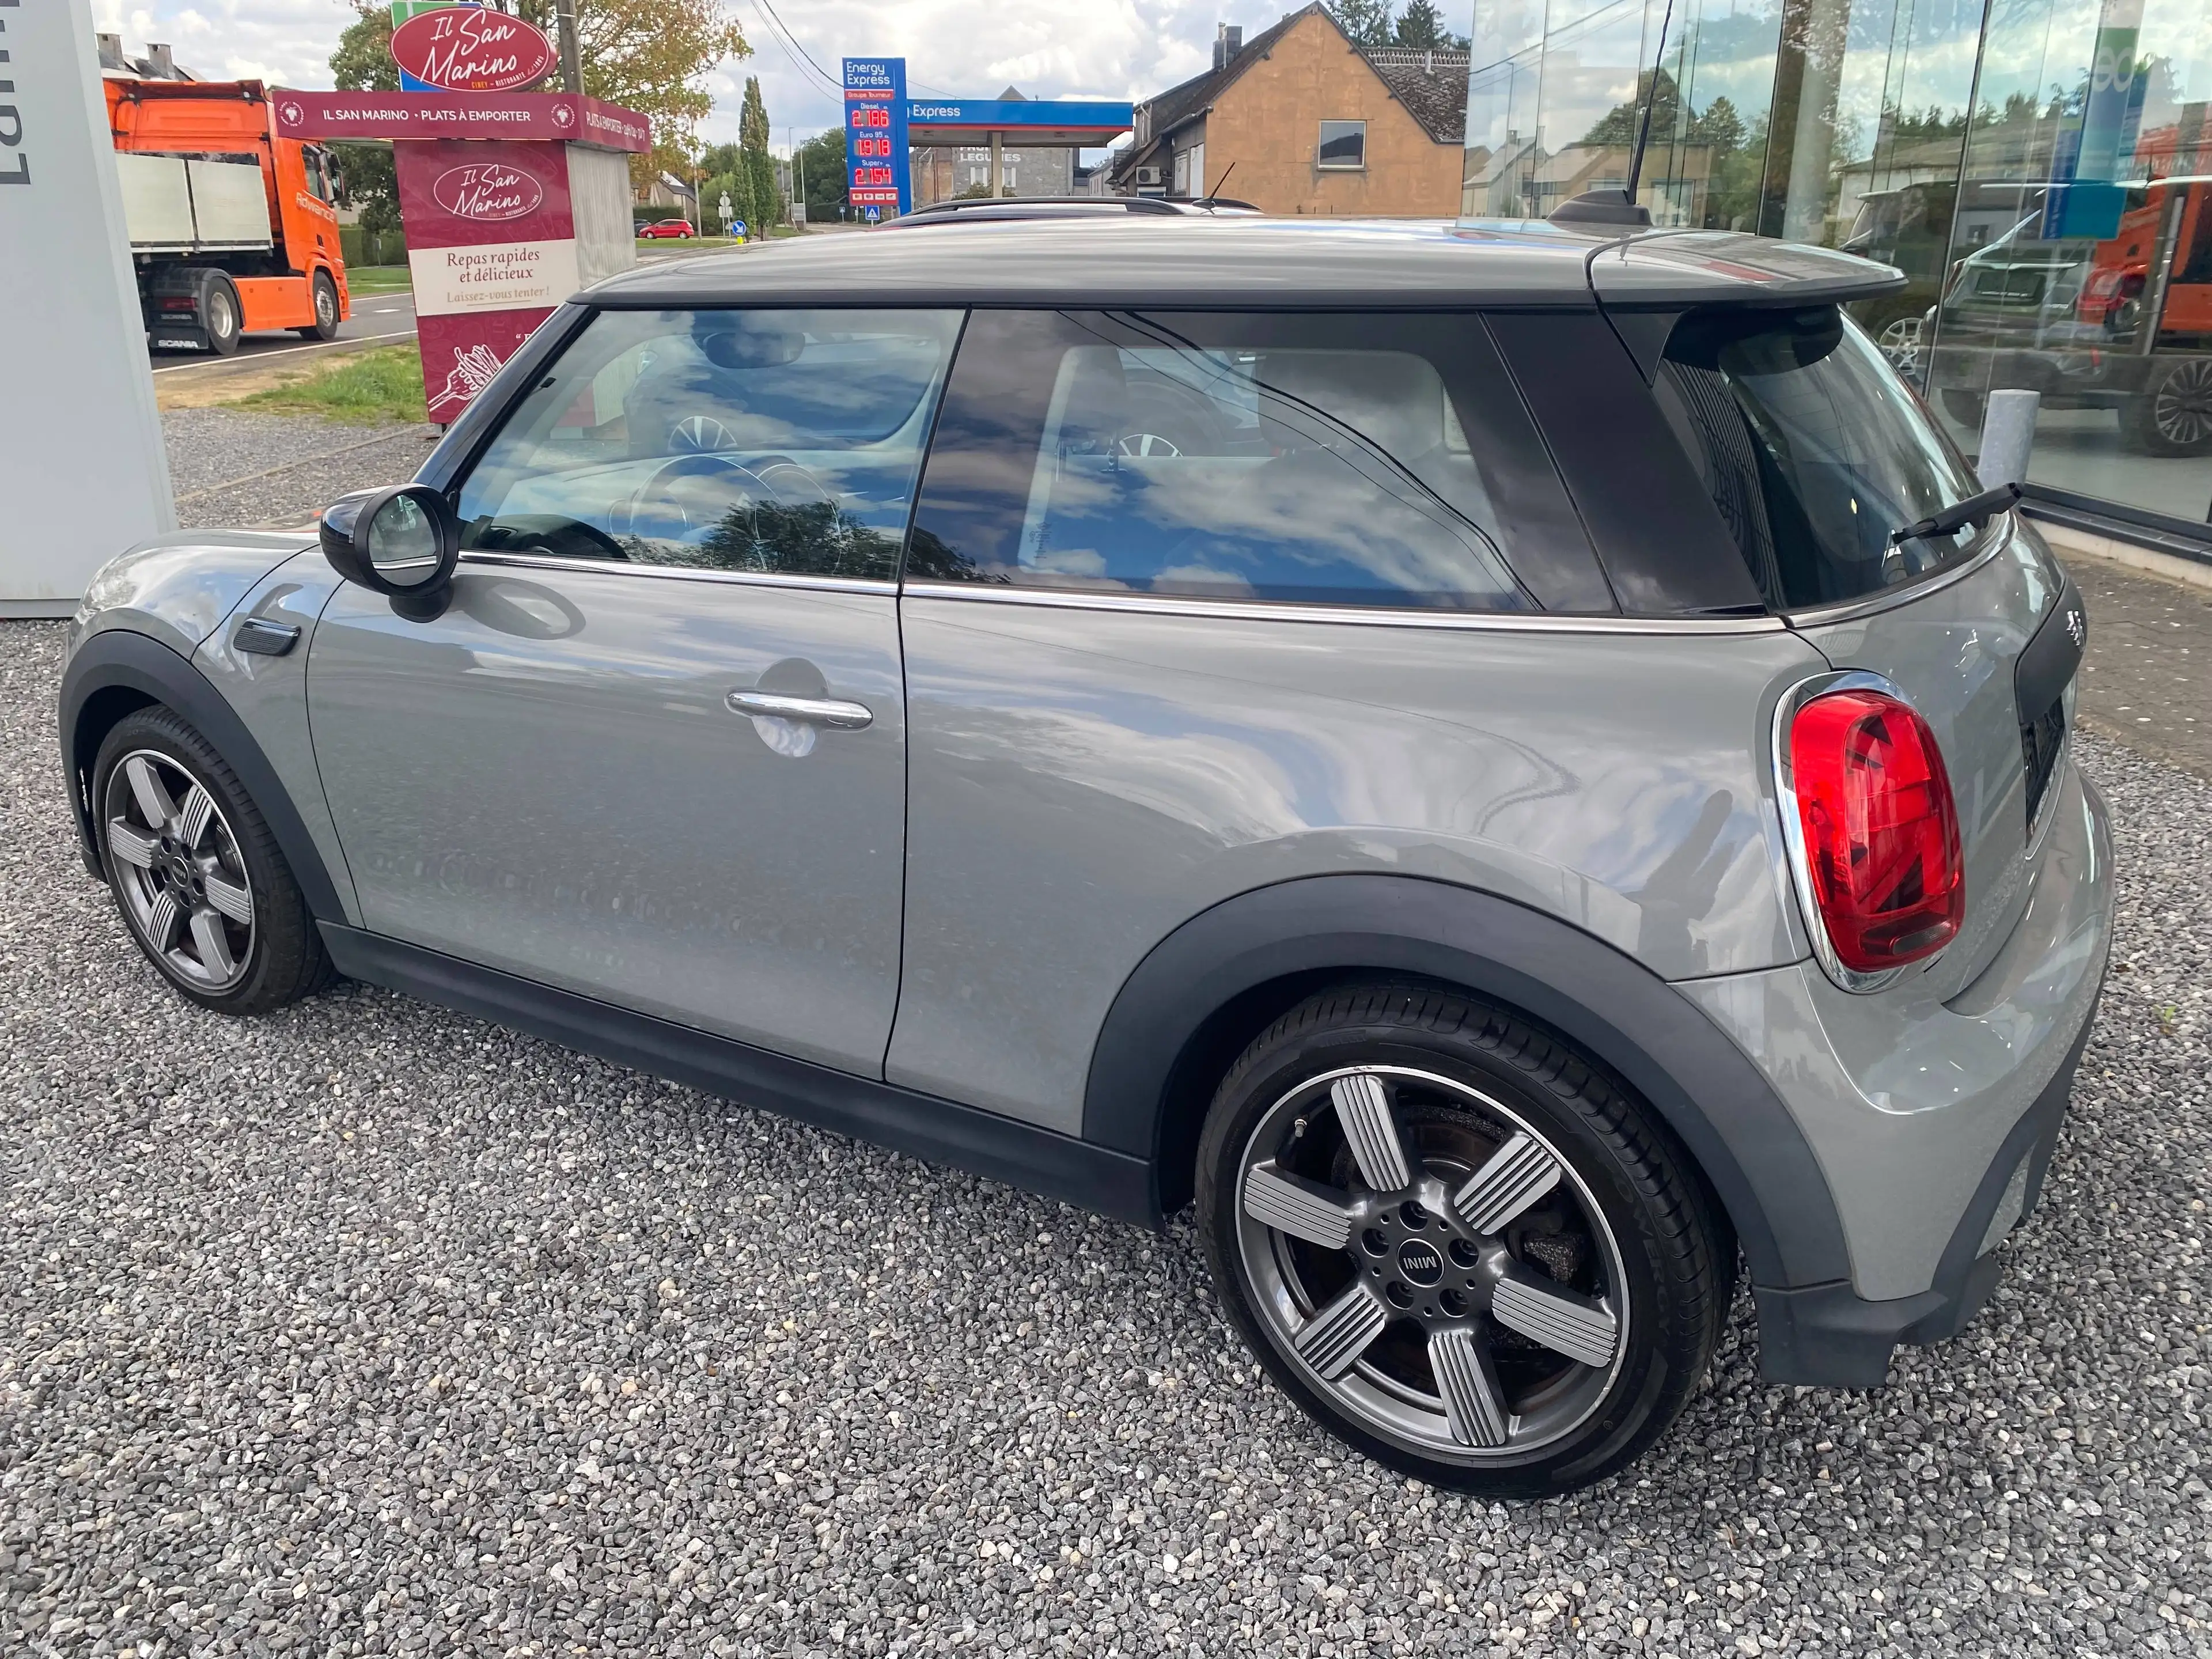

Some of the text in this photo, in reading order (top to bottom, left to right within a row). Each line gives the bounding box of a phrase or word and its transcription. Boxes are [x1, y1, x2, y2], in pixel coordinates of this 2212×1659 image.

[430, 9, 516, 56] Il San
[419, 40, 517, 86] Marino
[846, 62, 885, 75] Energy
[847, 74, 890, 86] Express
[323, 108, 531, 122] IL SAN MARINO PLATS À EMPORTER
[913, 104, 960, 120] Express
[960, 153, 1021, 162] LEGUES
[460, 164, 520, 196] Il San
[855, 168, 892, 185] 2.154
[453, 185, 520, 216] Marino
[447, 248, 540, 269] Repas rapides
[460, 266, 533, 283] et délicieux
[447, 290, 512, 303] Laissez-vous
[158, 339, 199, 348] SCANIA
[1403, 1256, 1438, 1270] MINI
